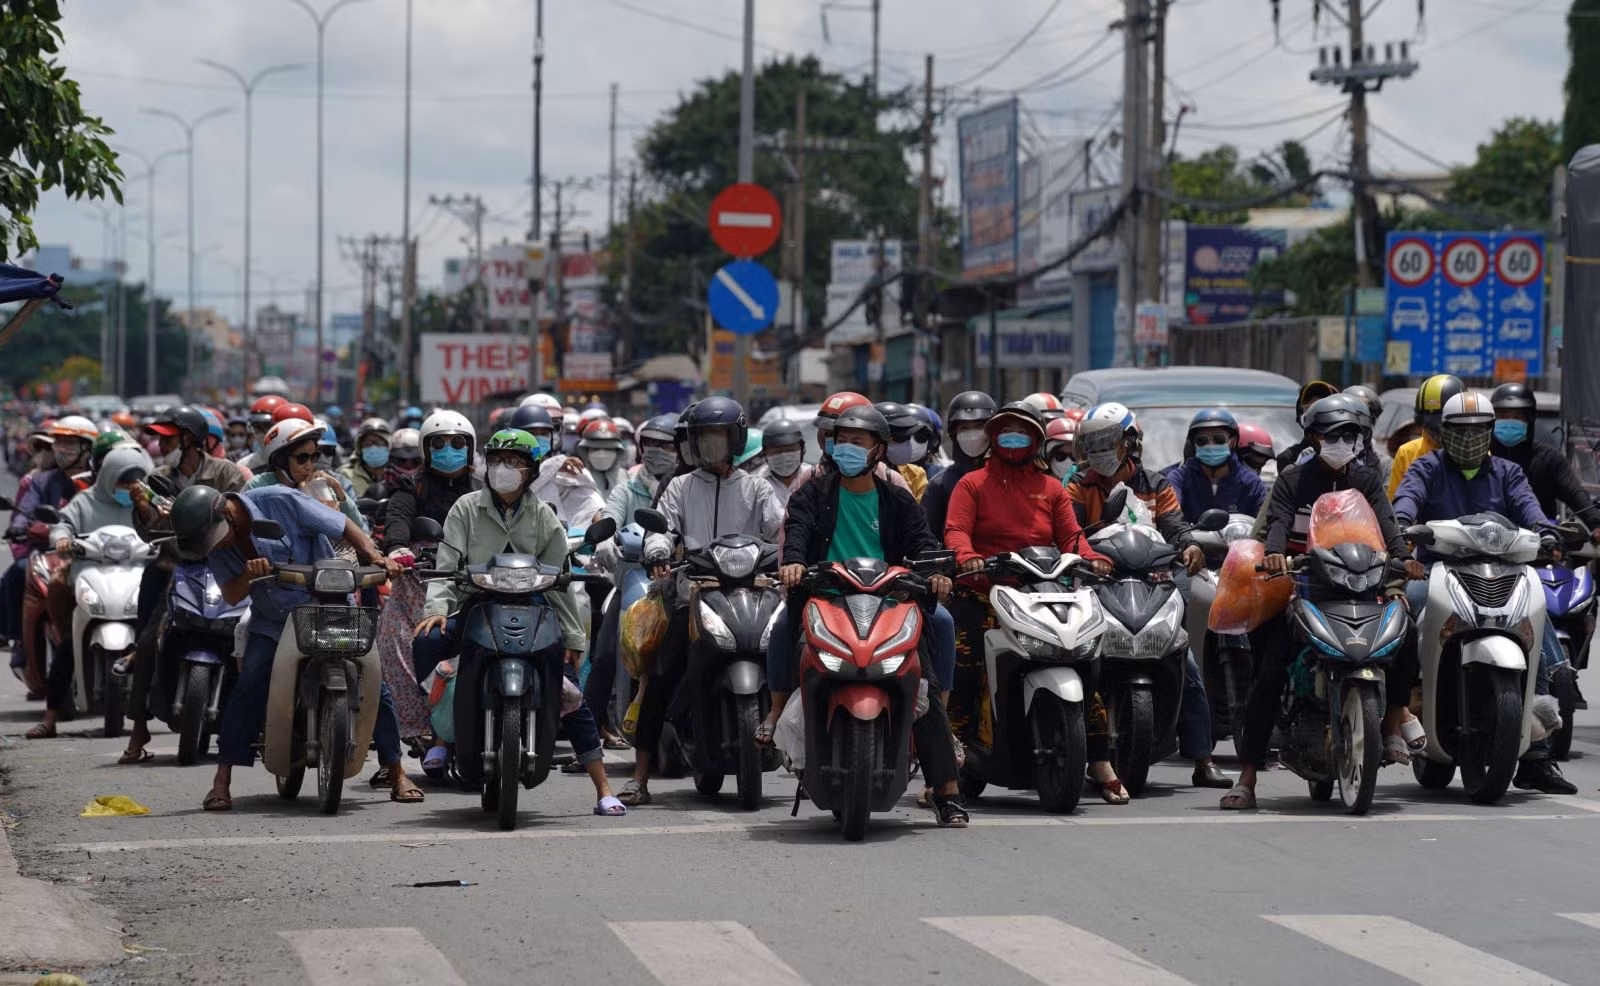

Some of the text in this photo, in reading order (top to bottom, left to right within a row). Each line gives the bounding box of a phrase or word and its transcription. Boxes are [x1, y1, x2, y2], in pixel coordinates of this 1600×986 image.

[1399, 250, 1423, 273] 60
[1454, 250, 1477, 273] 60
[1508, 250, 1532, 273] 60
